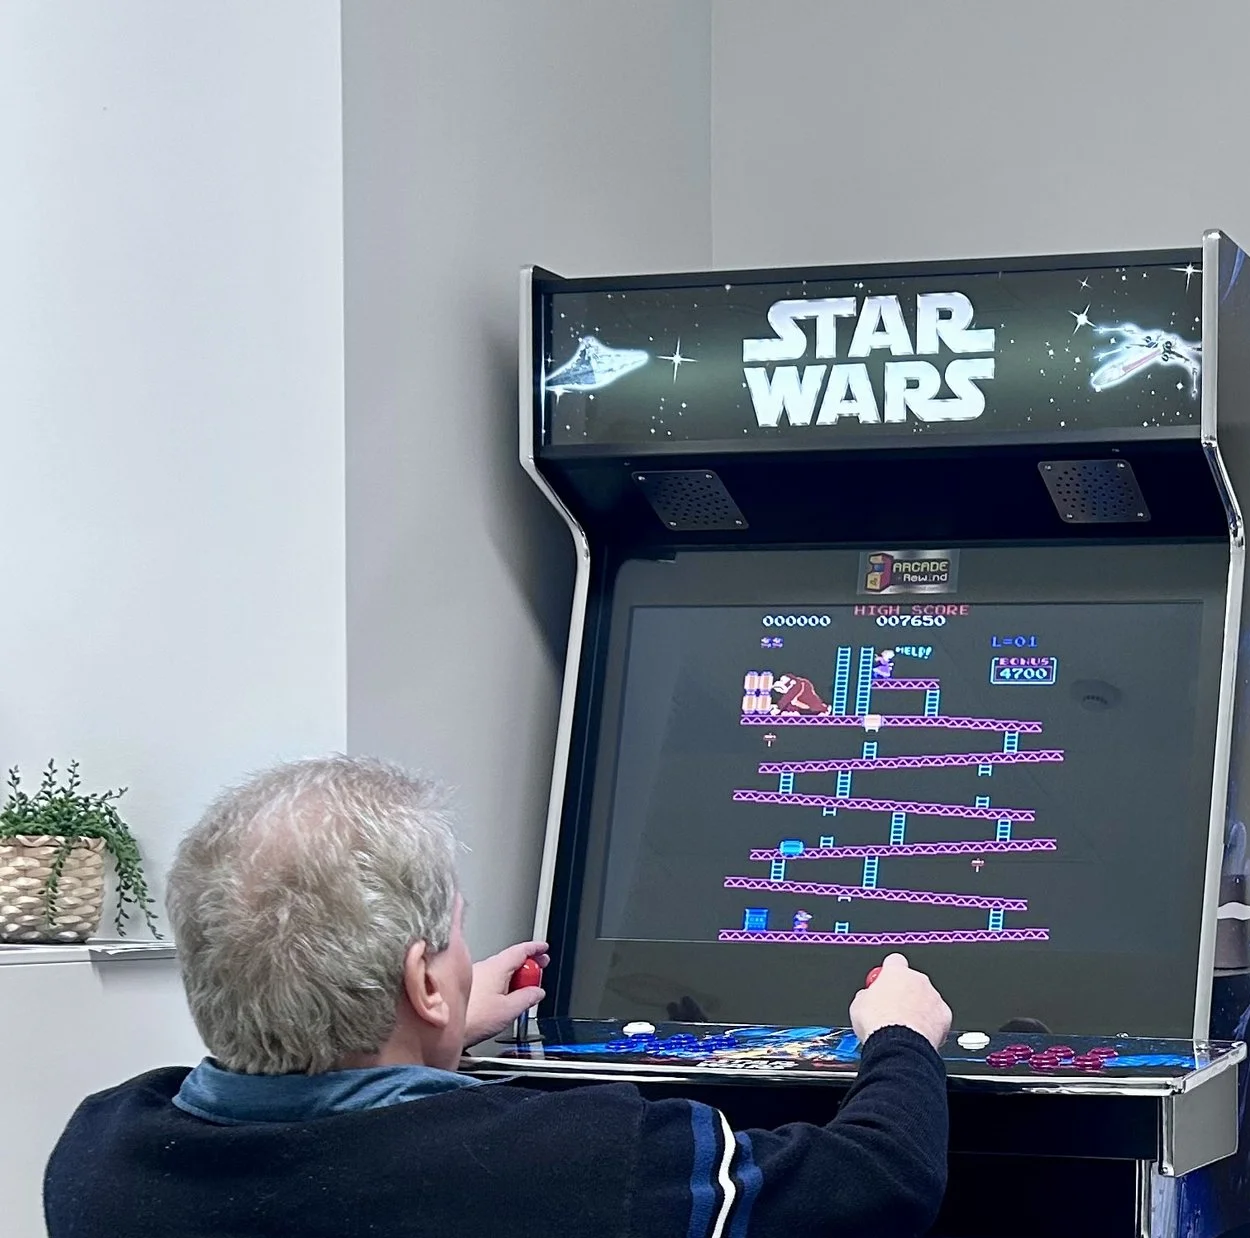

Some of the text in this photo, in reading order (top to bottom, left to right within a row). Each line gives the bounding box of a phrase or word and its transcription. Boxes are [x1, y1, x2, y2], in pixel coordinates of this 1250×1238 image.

[742, 290, 996, 362] STAR
[742, 357, 996, 428] WARS
[893, 561, 949, 573] ARCADE
[854, 605, 970, 615] HIGH SCORE
[762, 615, 946, 627] 000000 007650
[992, 636, 1037, 647] L=01
[999, 657, 1049, 666] BONUS
[1000, 667, 1048, 679] 4700
